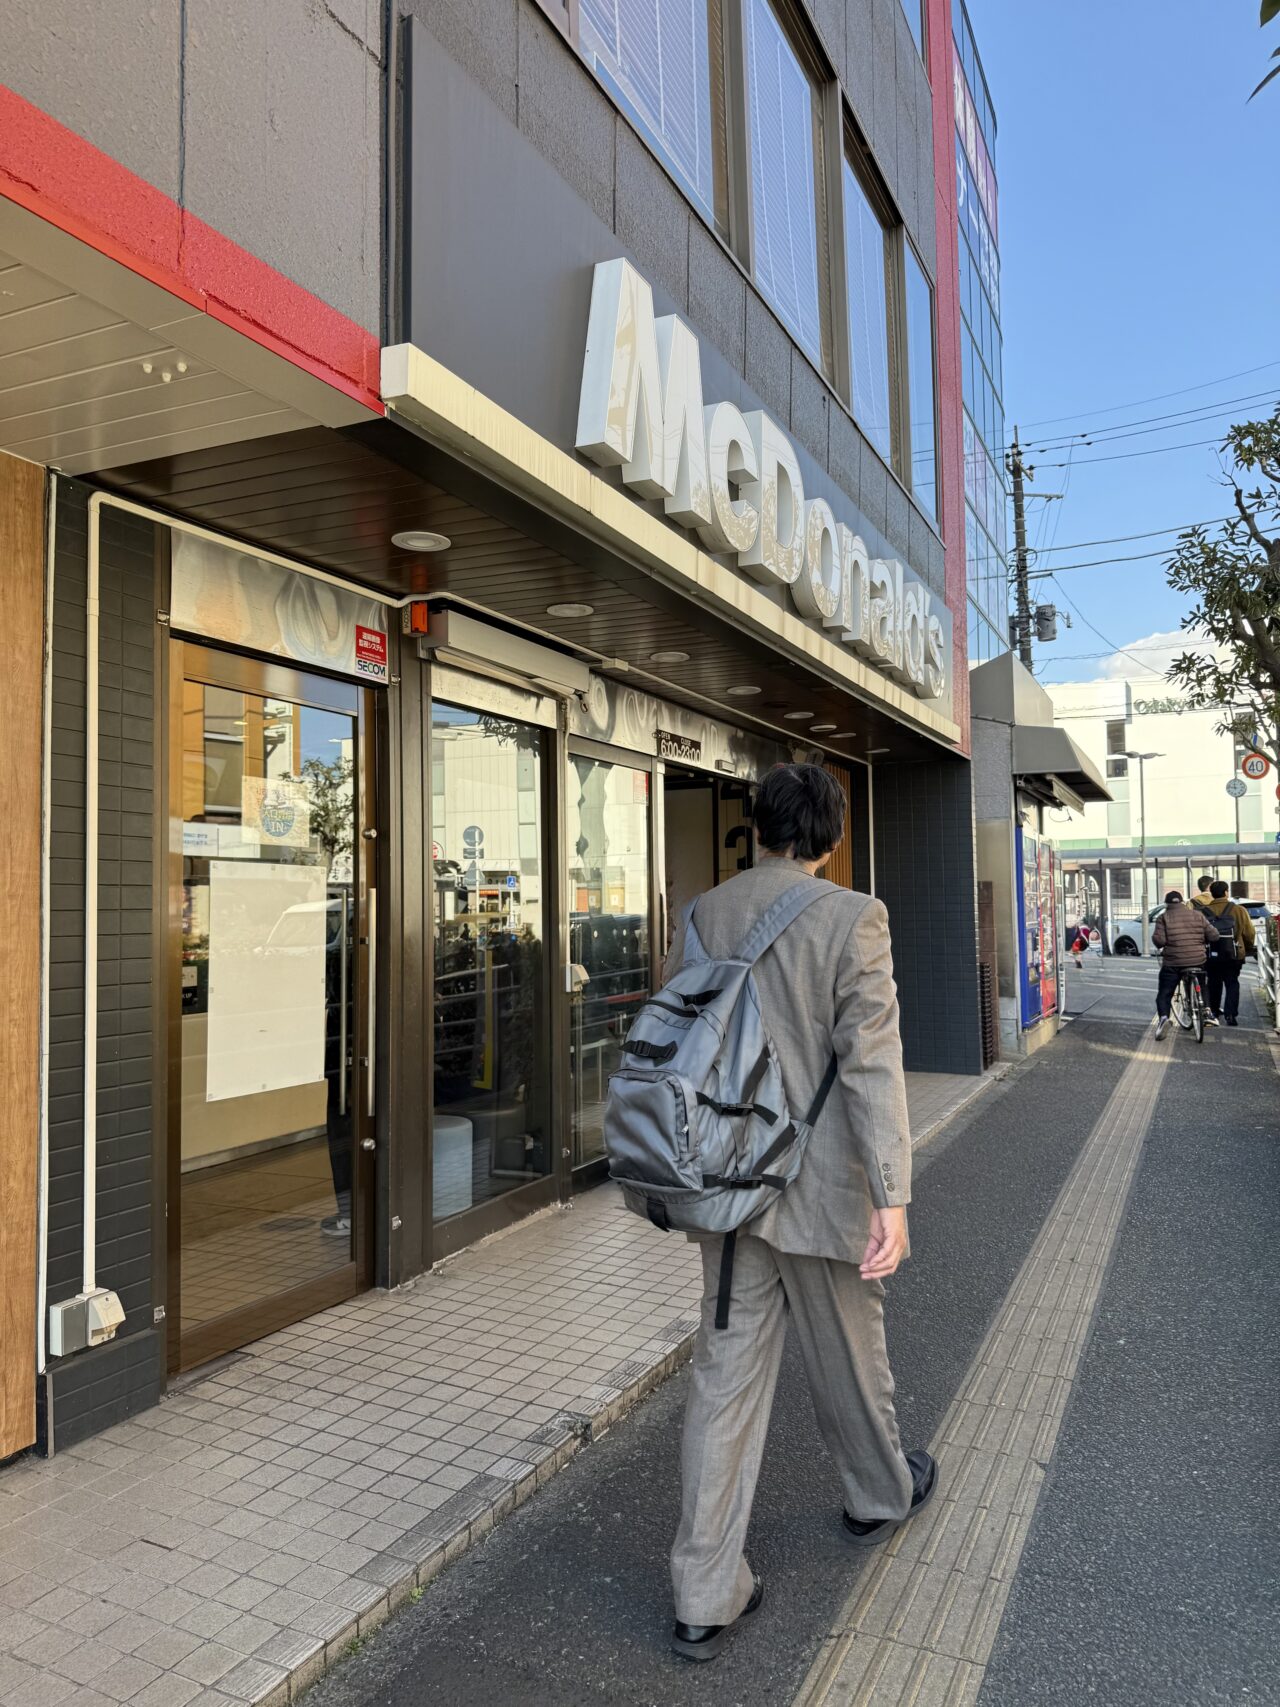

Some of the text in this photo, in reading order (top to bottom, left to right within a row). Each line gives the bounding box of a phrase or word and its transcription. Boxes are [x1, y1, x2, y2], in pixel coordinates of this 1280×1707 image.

[575, 256, 945, 699] McDonald's
[357, 659, 386, 677] SECOM
[661, 731, 692, 747] OPEN CLOSE
[1248, 760, 1264, 773] 40
[271, 821, 284, 832] IN
